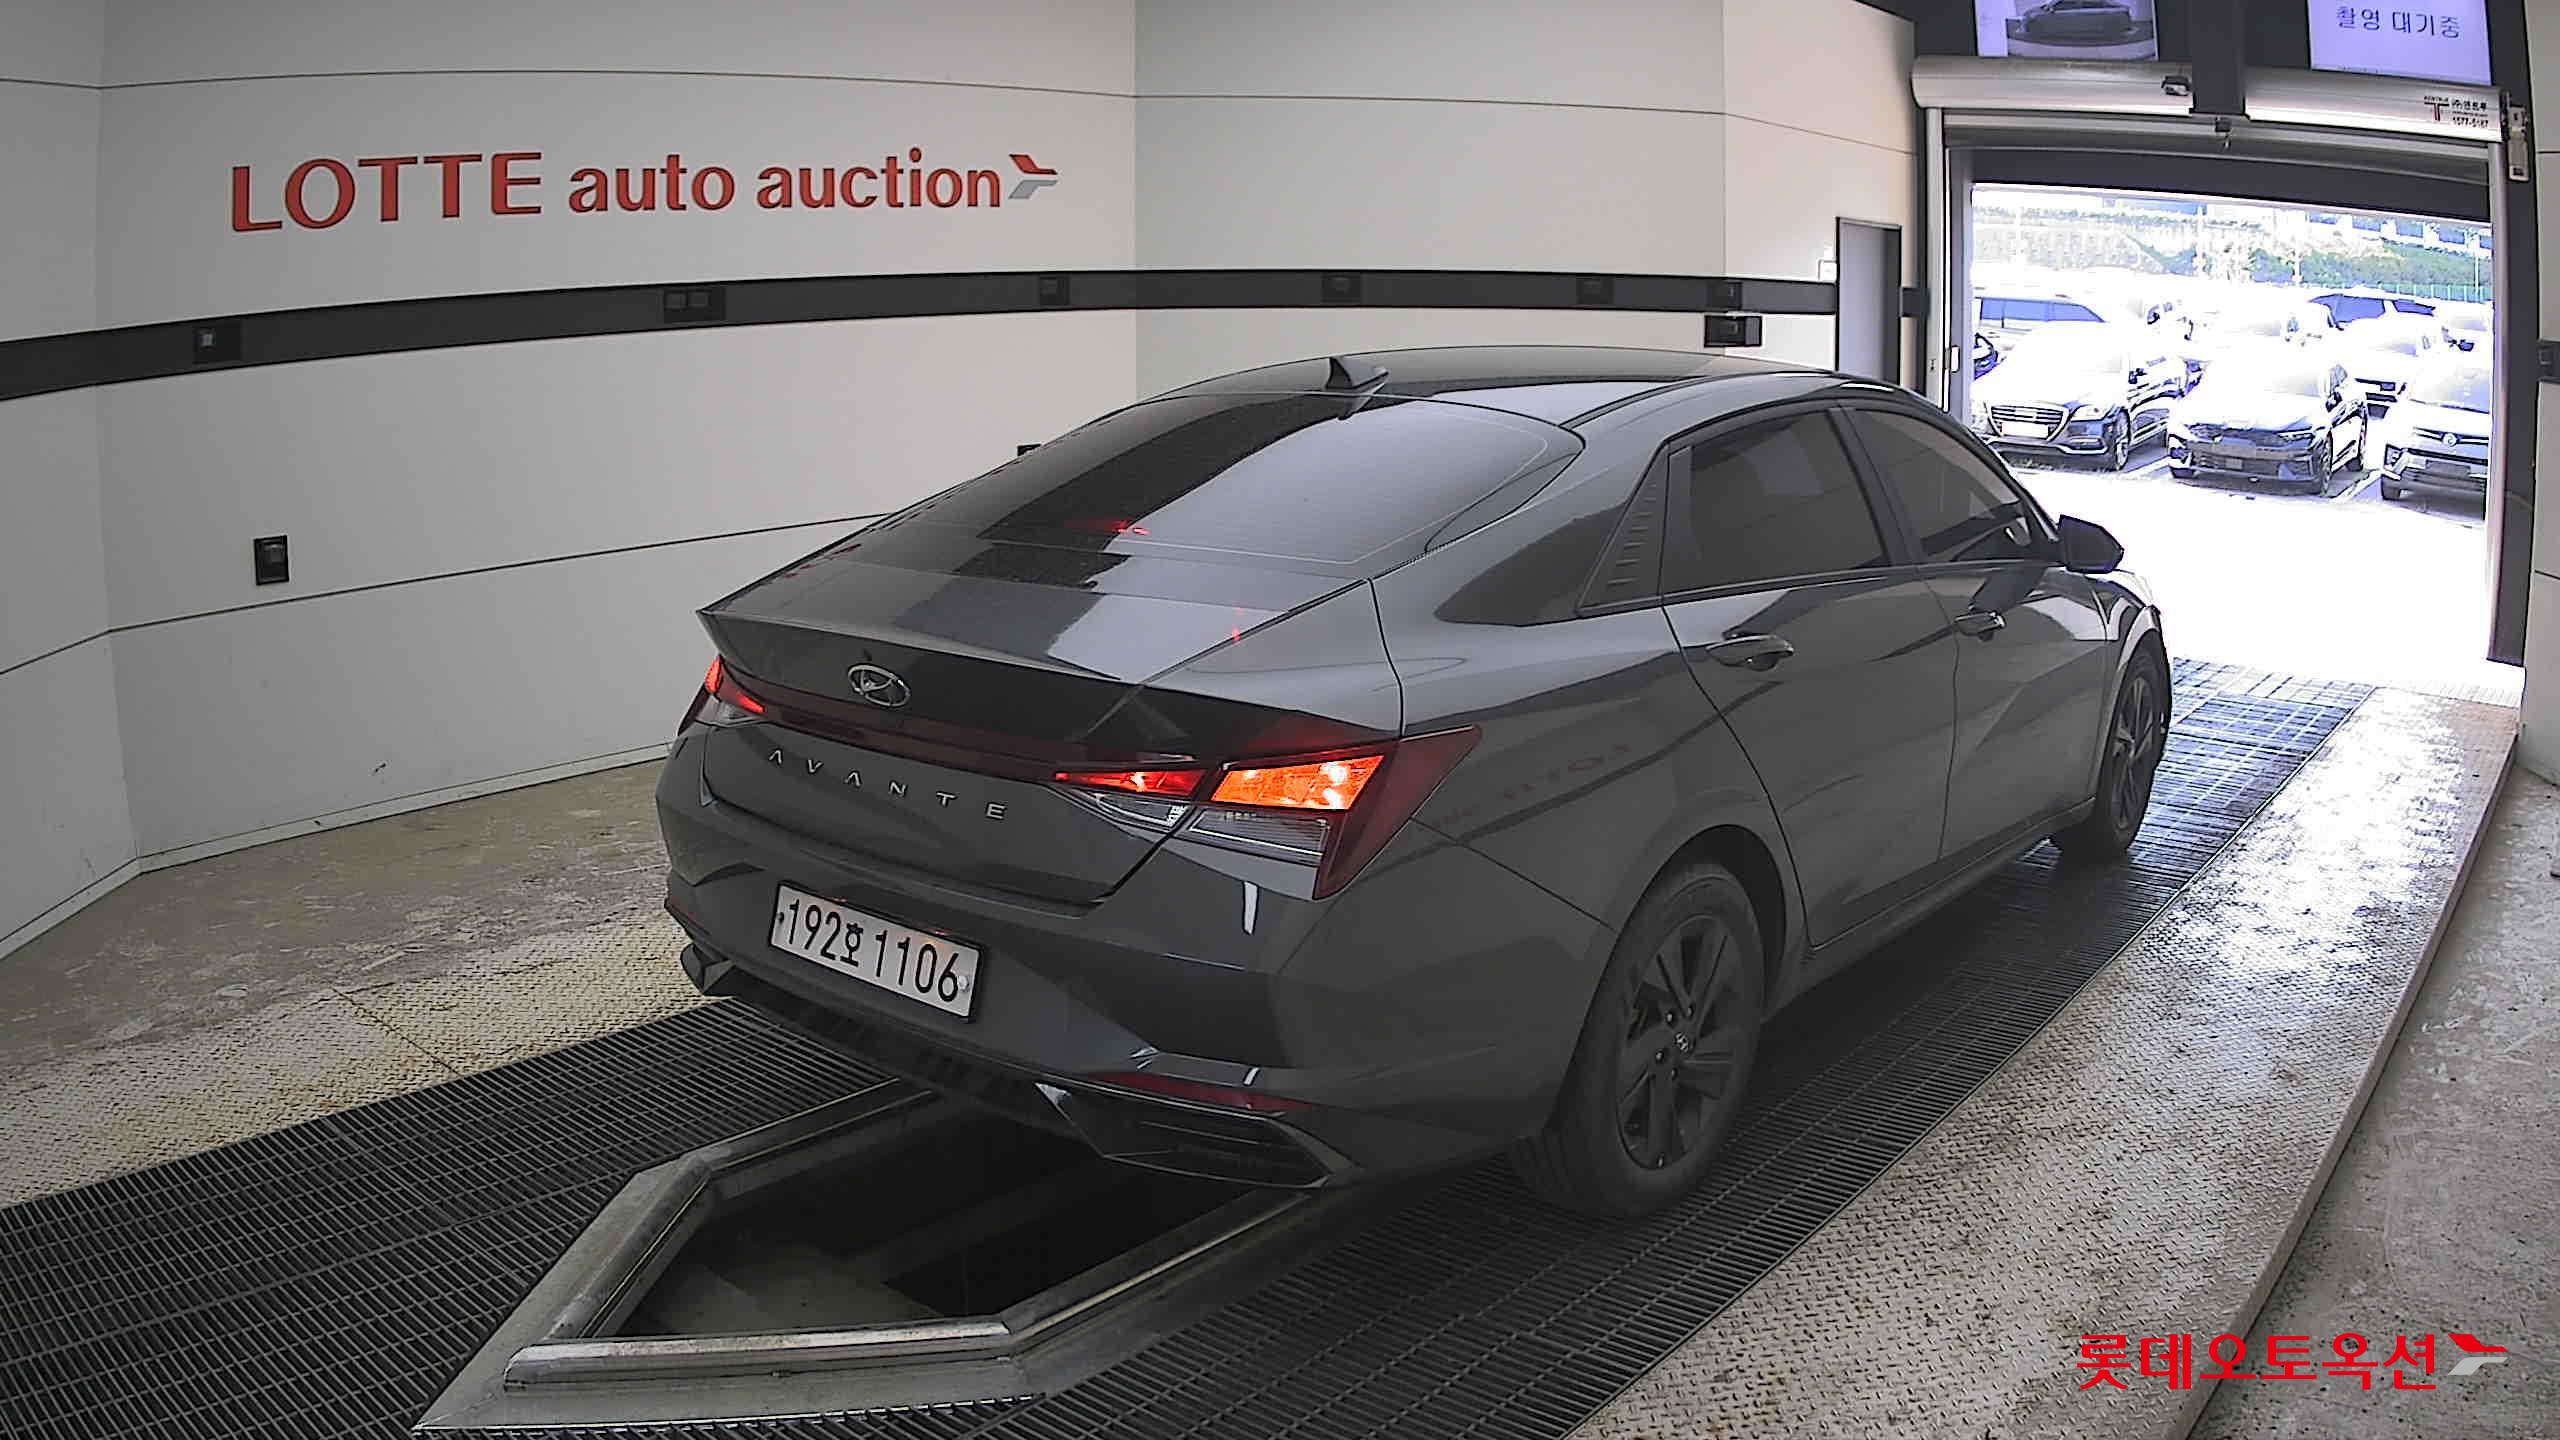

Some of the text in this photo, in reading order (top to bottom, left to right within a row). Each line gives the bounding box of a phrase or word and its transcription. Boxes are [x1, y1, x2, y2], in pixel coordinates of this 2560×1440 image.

[2335, 6, 2460, 39] 촬영 대기중
[232, 148, 1001, 232] LOTTE auto auction
[768, 749, 1007, 821] AVANTE
[788, 898, 959, 1003] 192호 1106
